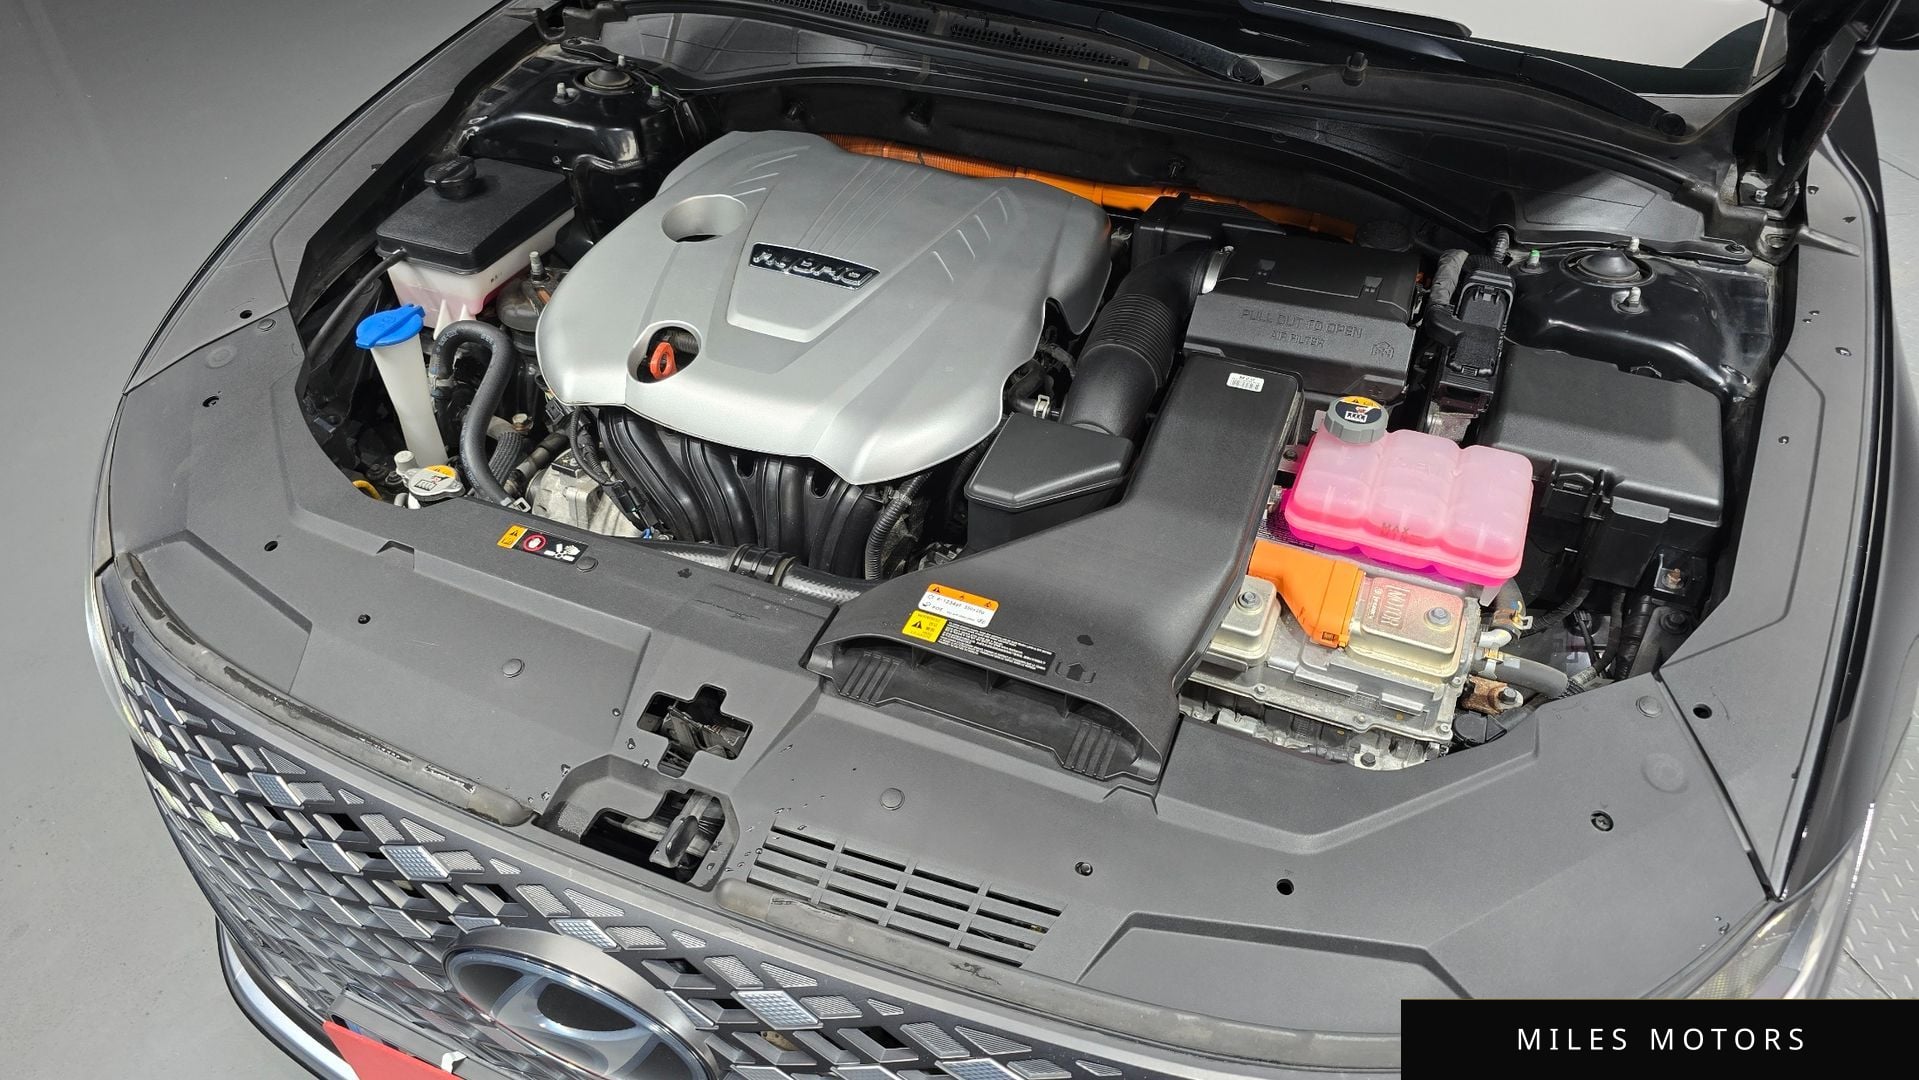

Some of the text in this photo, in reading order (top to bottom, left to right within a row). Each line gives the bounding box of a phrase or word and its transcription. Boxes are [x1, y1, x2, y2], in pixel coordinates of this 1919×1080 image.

[1240, 308, 1274, 324] PULL
[1277, 313, 1302, 329] OUT
[1326, 321, 1363, 339] OPEN
[1270, 329, 1325, 348] AIR FILTER
